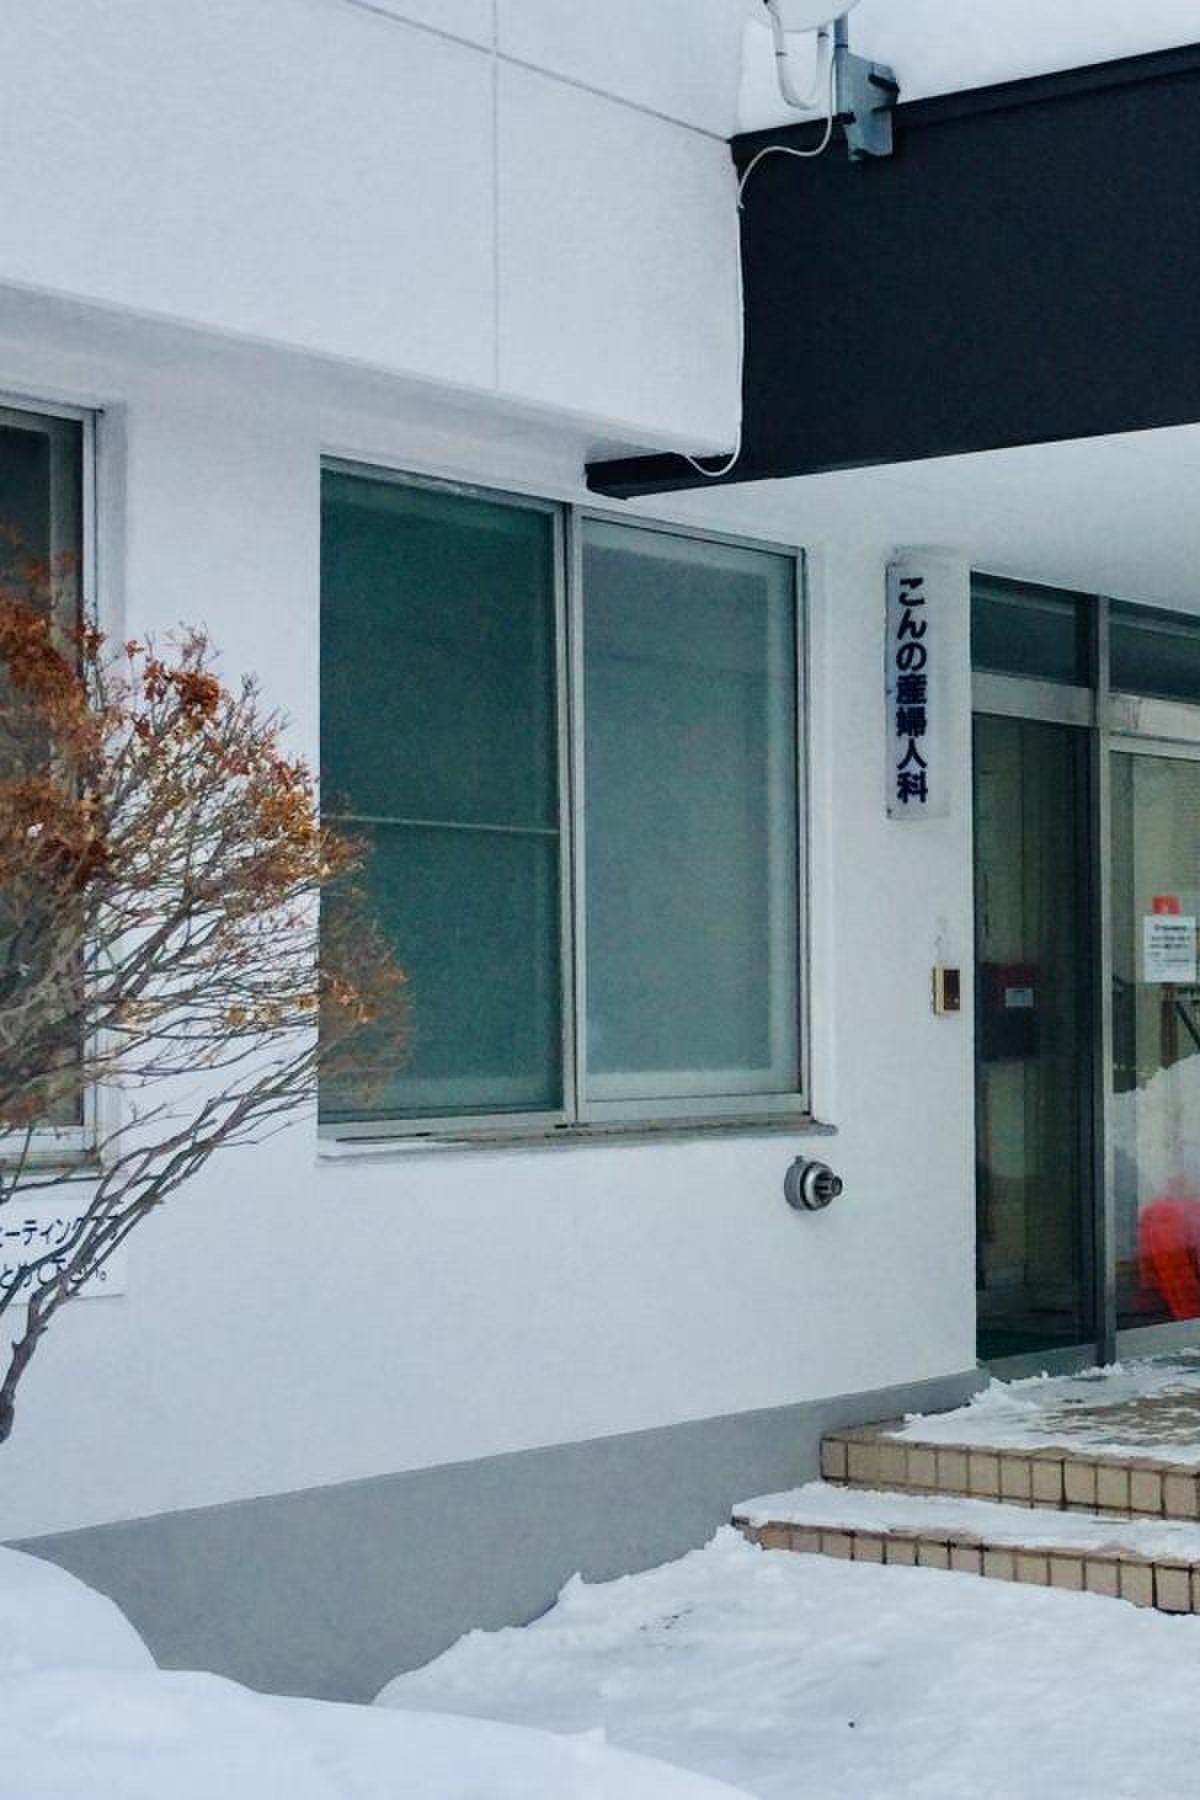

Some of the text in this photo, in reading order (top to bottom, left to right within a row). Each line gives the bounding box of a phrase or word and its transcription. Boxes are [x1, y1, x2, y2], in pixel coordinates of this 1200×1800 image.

[895, 576, 928, 804] こんの産婦人科
